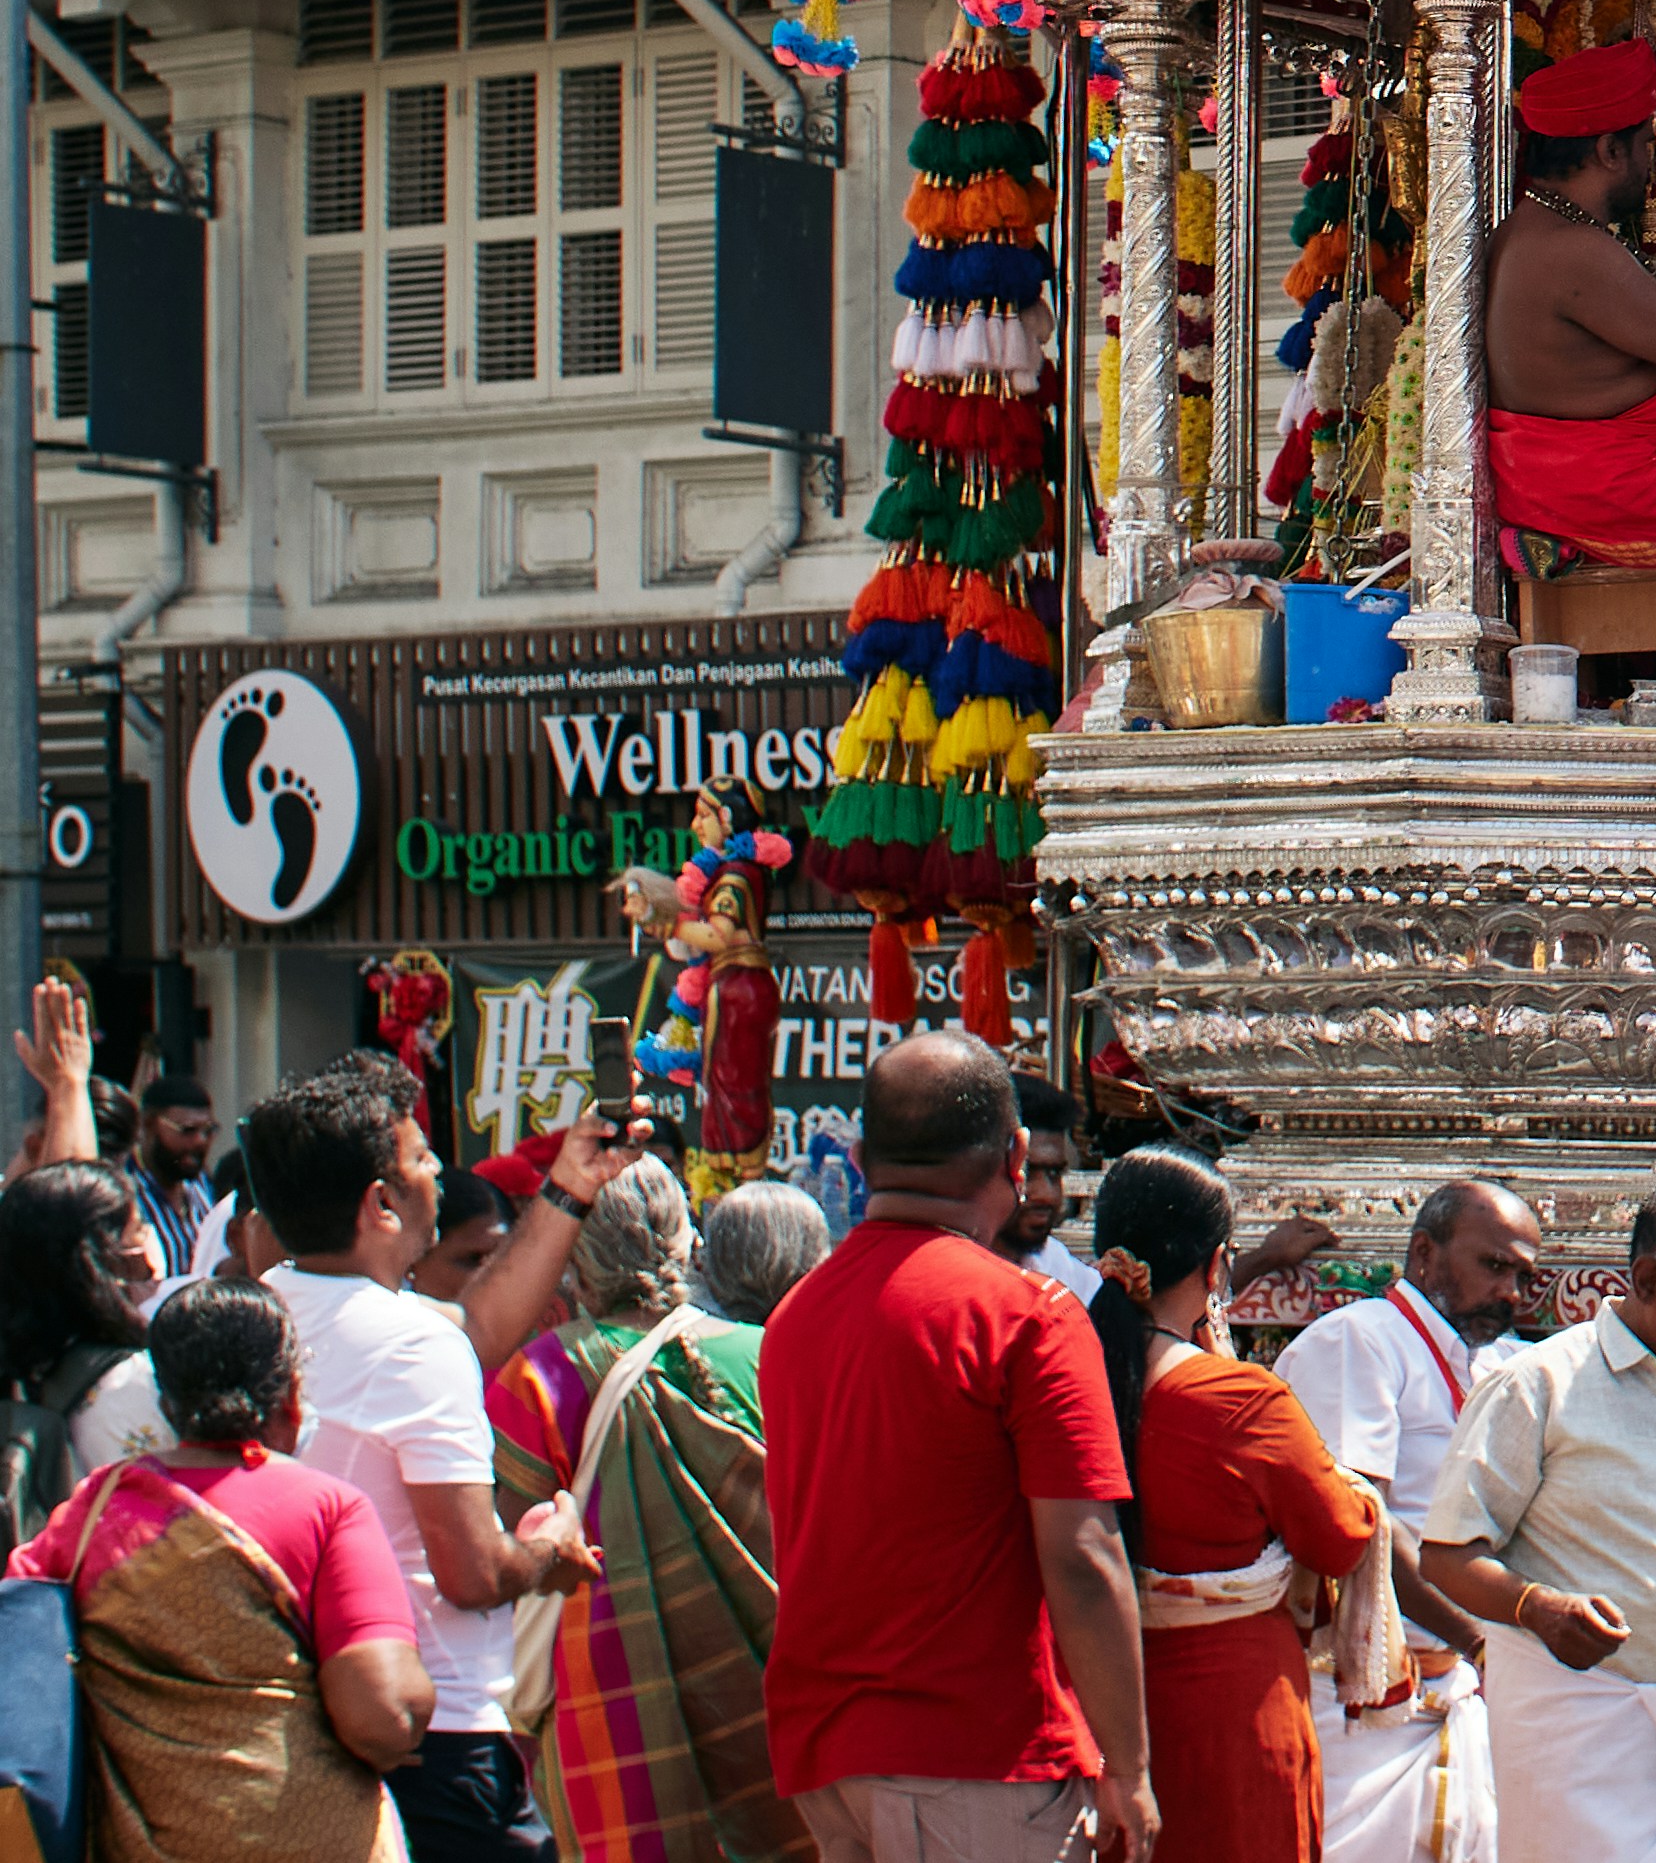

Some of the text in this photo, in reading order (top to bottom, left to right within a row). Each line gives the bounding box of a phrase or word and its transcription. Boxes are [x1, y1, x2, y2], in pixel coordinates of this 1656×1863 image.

[422, 674, 469, 696] Pusat
[471, 672, 567, 697] Kecergasan
[660, 663, 696, 685] Dan
[697, 660, 785, 686] Penjagaan
[397, 813, 597, 896] Organic
